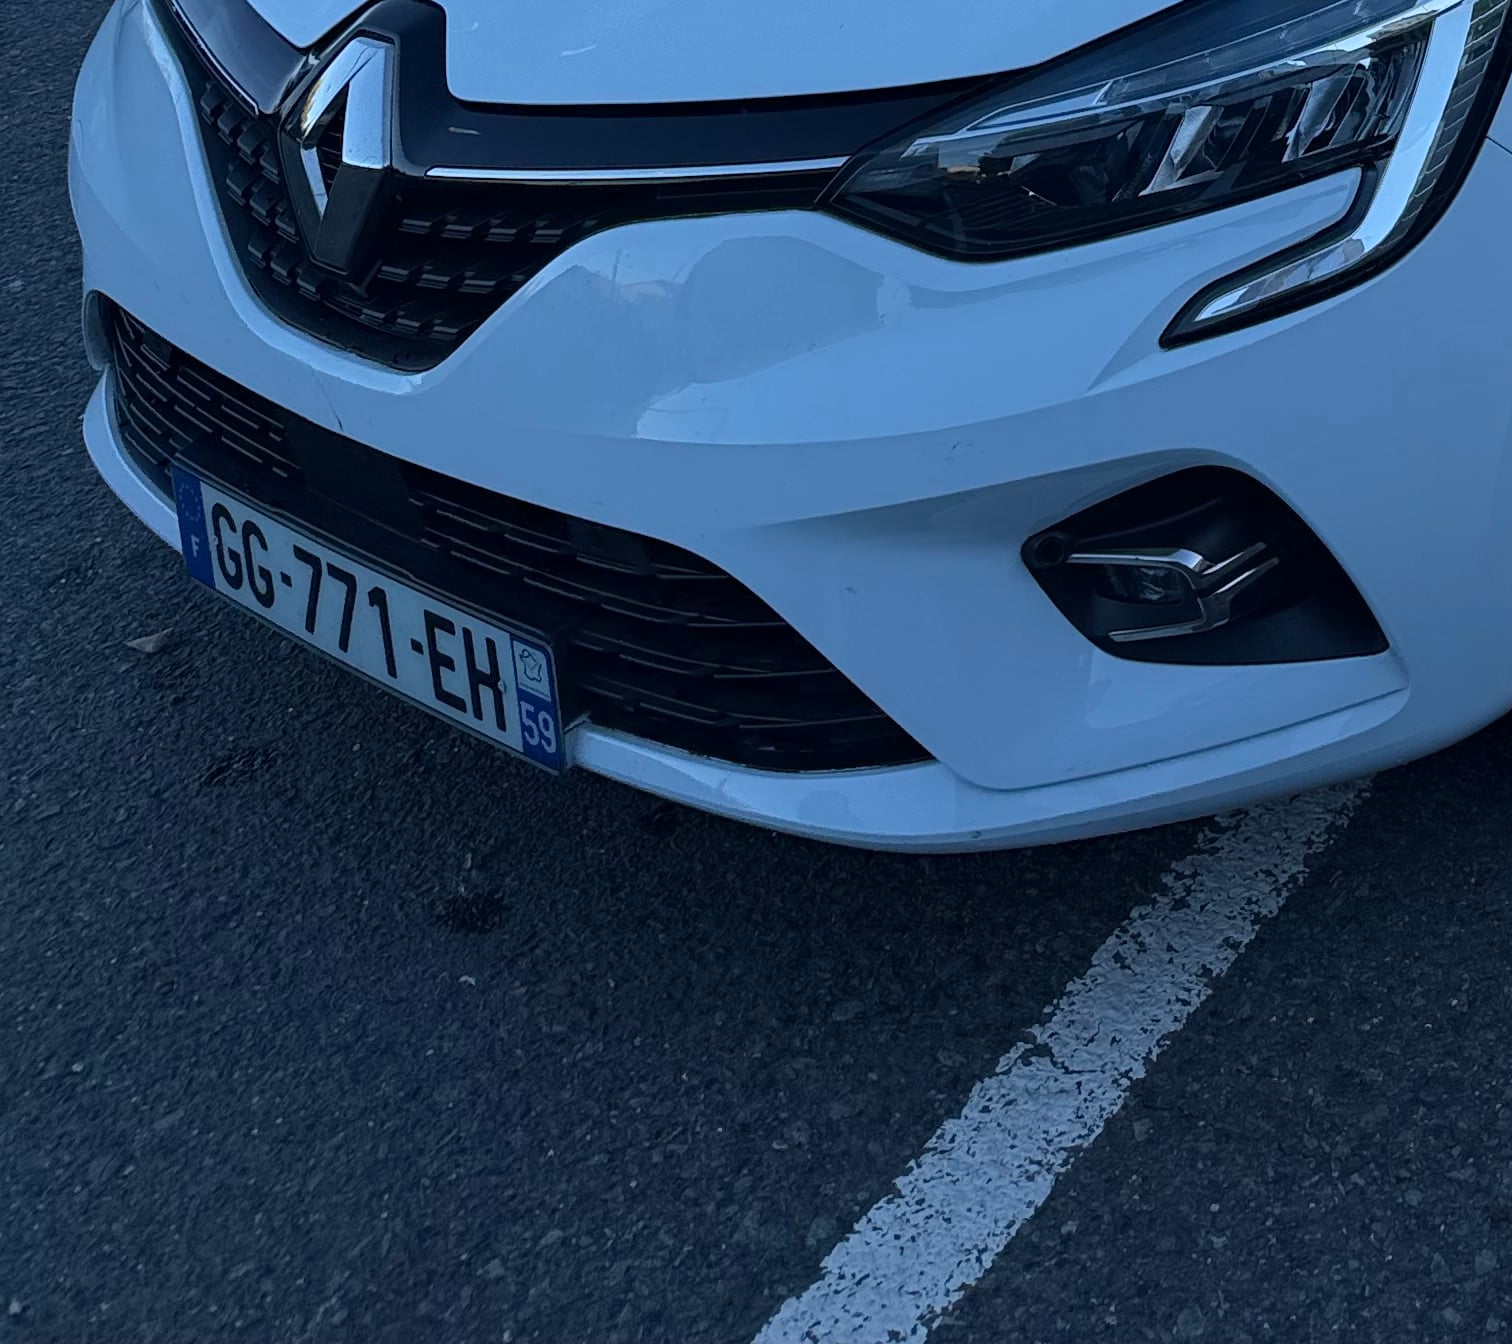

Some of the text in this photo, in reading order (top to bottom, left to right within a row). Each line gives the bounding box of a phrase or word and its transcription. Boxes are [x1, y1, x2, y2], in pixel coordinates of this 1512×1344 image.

[190, 533, 201, 559] F
[210, 501, 508, 734] GG-771-EH
[520, 700, 557, 754] 59
